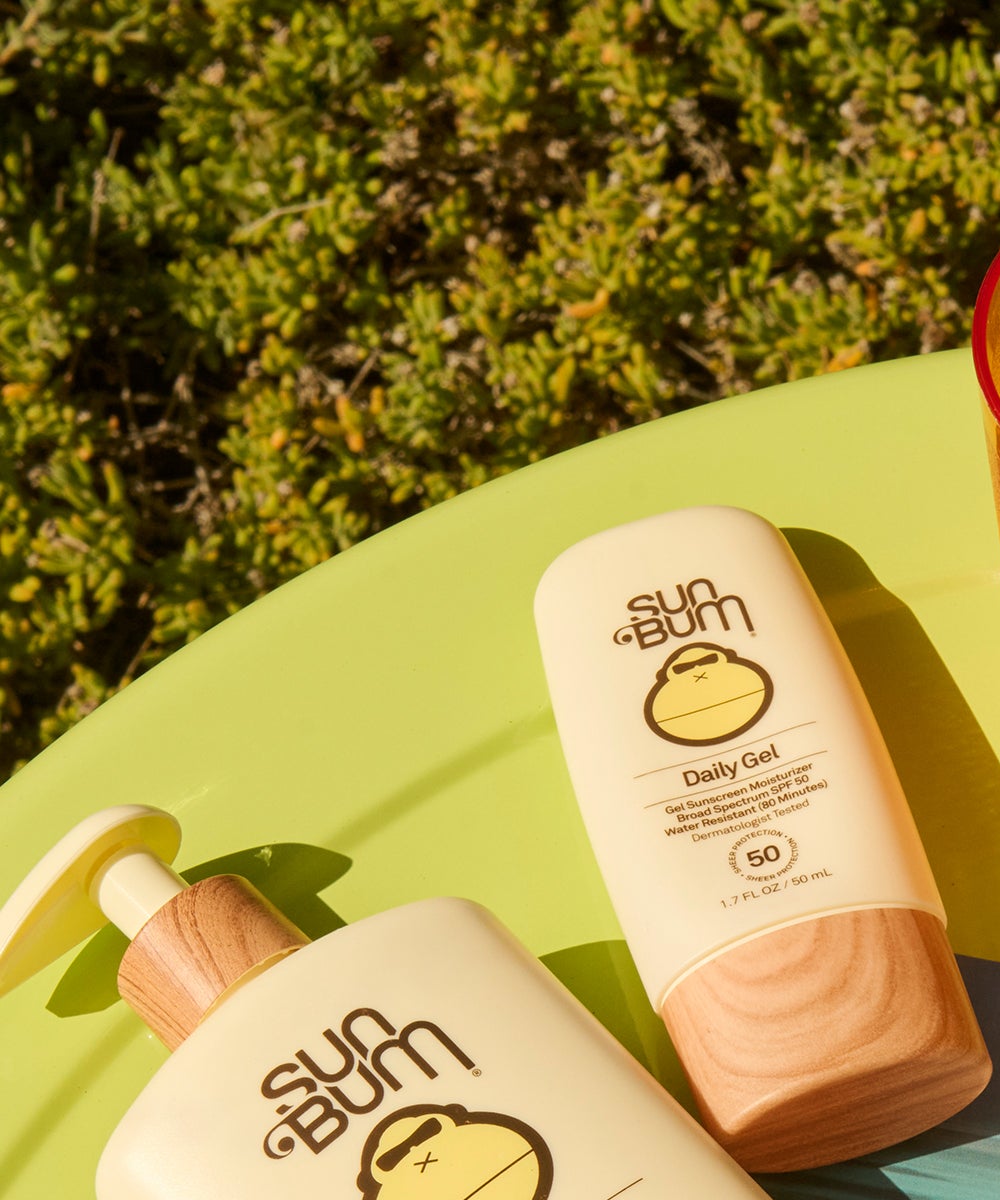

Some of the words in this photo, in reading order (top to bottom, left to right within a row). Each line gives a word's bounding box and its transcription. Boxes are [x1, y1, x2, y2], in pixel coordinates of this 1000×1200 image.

[682, 761, 737, 787] Daily
[741, 744, 780, 769] Gel
[664, 823, 699, 836] Water
[701, 806, 757, 827] Resistant
[758, 798, 776, 812] (80
[777, 779, 827, 803] Minutes)
[665, 803, 685, 814] Gel
[686, 788, 748, 809] Sunscreen
[749, 763, 812, 791] Moisturizer
[677, 807, 712, 822] Broad
[713, 791, 769, 813] Spectrum
[770, 780, 793, 794] SPF
[794, 775, 809, 785] 50
[692, 814, 771, 842] Dermatologist
[773, 799, 809, 817] Tested
[746, 845, 780, 867] 50
[721, 896, 738, 908] 1.7
[742, 891, 760, 901] FL
[762, 883, 781, 894] OZ
[792, 875, 808, 885] 50
[811, 869, 832, 880] mL
